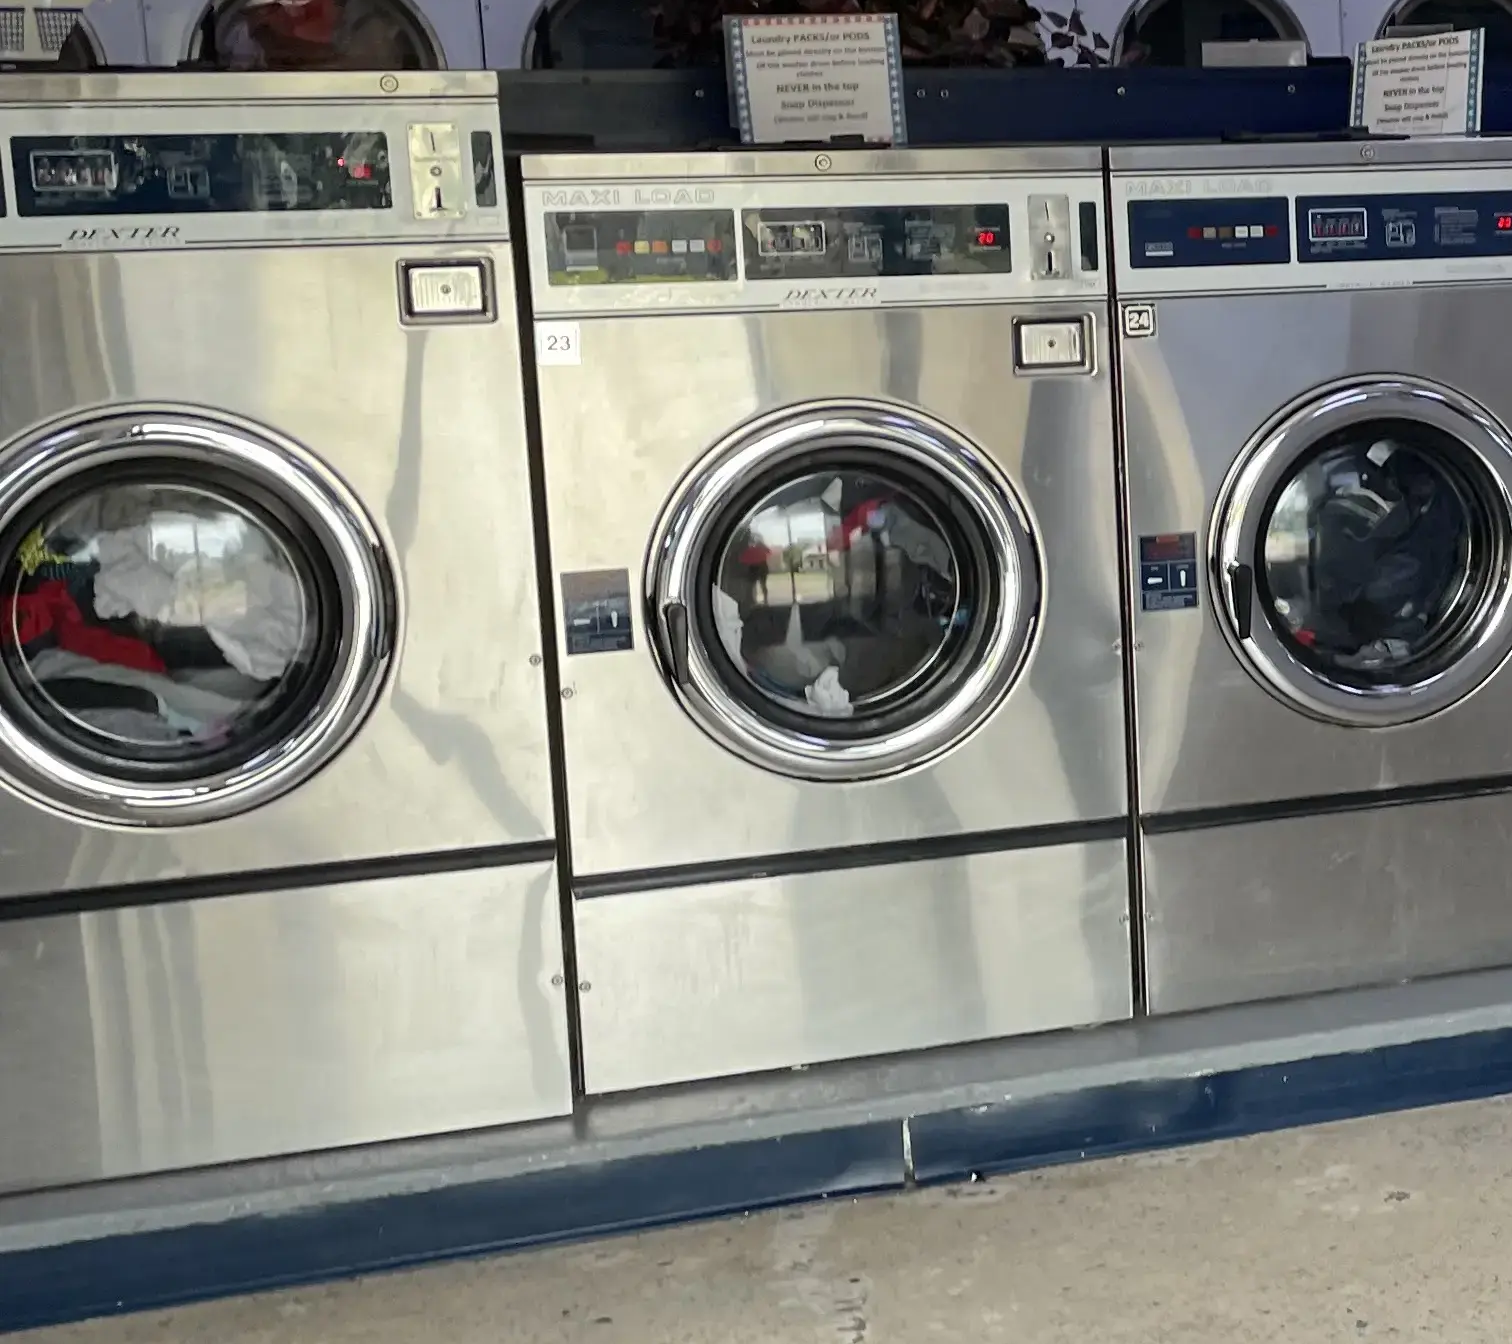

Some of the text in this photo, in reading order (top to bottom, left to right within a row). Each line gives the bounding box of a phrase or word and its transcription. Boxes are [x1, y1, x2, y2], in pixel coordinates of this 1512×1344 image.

[751, 34, 791, 45] Laundry
[842, 31, 870, 42] PODS
[776, 83, 810, 94] NEVER
[823, 82, 840, 92] the
[842, 82, 859, 94] top
[1125, 177, 1272, 197] MAXI LOAD
[541, 188, 715, 207] MAXI LOAD
[67, 227, 181, 241] DEXTER
[785, 287, 877, 300] DEXTER
[1129, 312, 1150, 329] 24
[547, 335, 571, 351] 23
